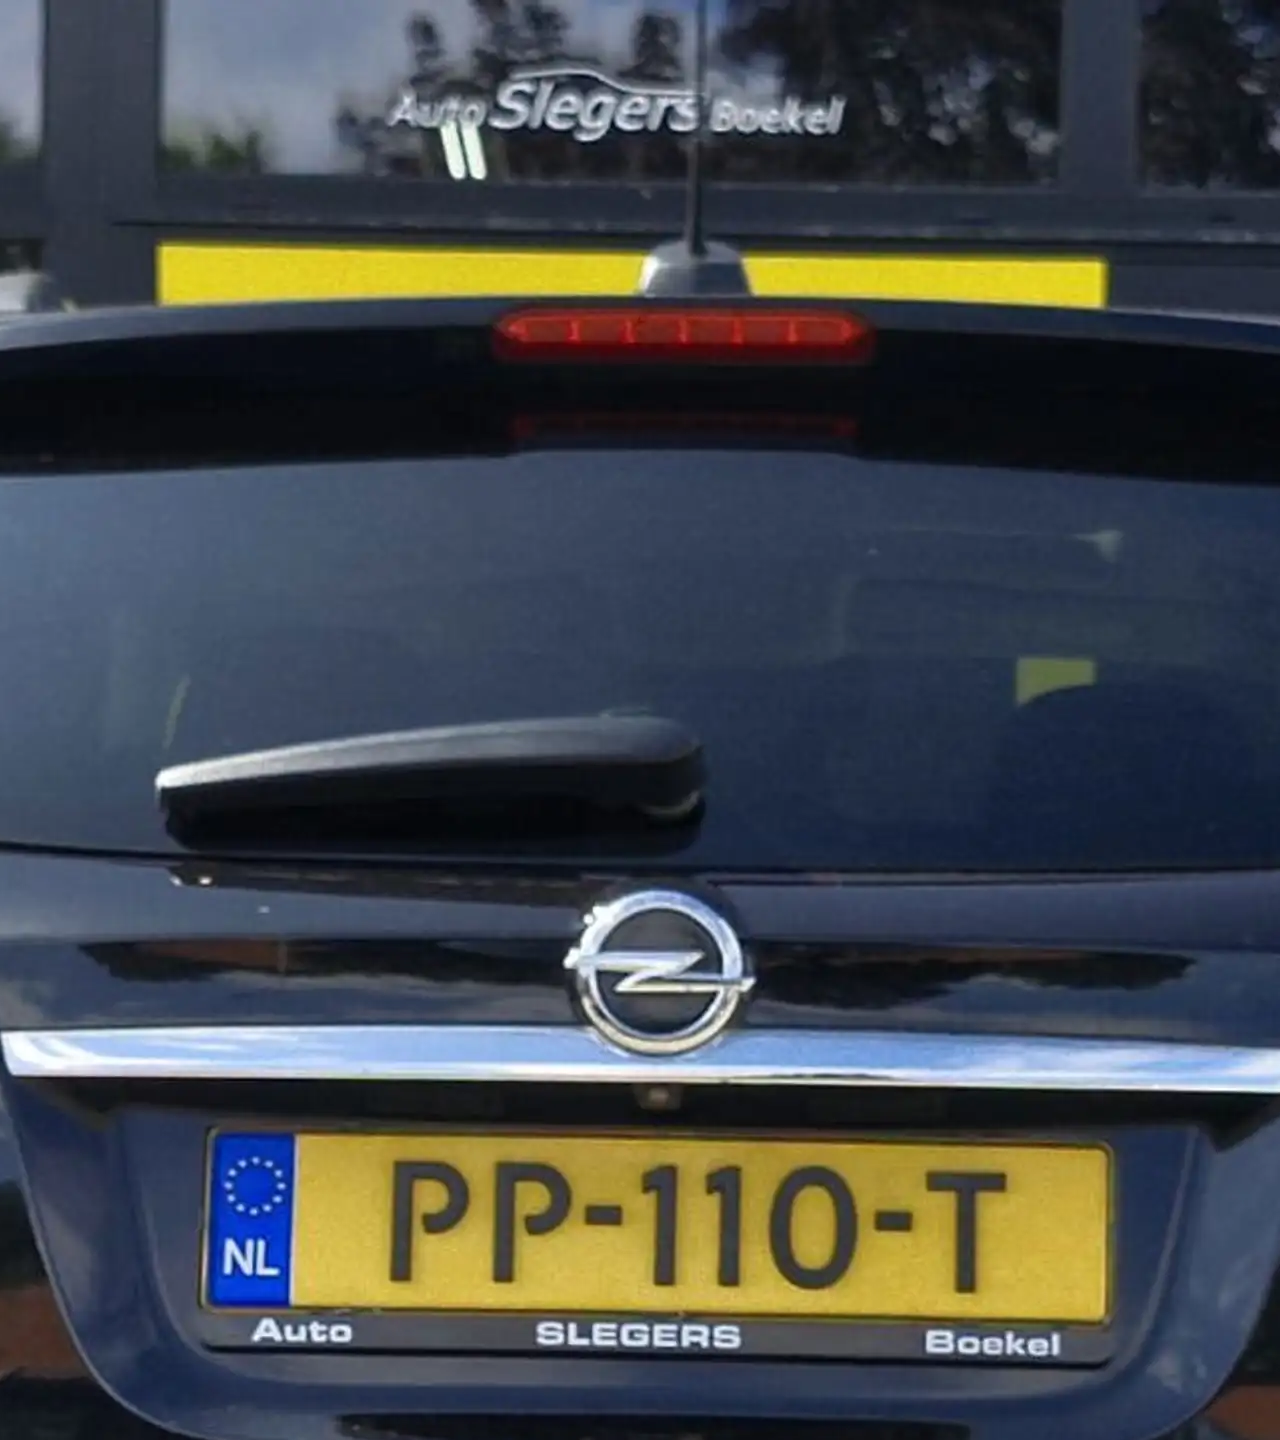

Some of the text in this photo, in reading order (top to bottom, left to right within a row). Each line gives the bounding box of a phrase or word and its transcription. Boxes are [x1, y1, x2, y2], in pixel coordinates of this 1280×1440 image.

[387, 78, 846, 142] Auto Slegers Boekel
[388, 1159, 1008, 1294] PP-110-T
[223, 1239, 280, 1278] NL
[251, 1316, 1061, 1358] Auto SLEGERS Boekel
